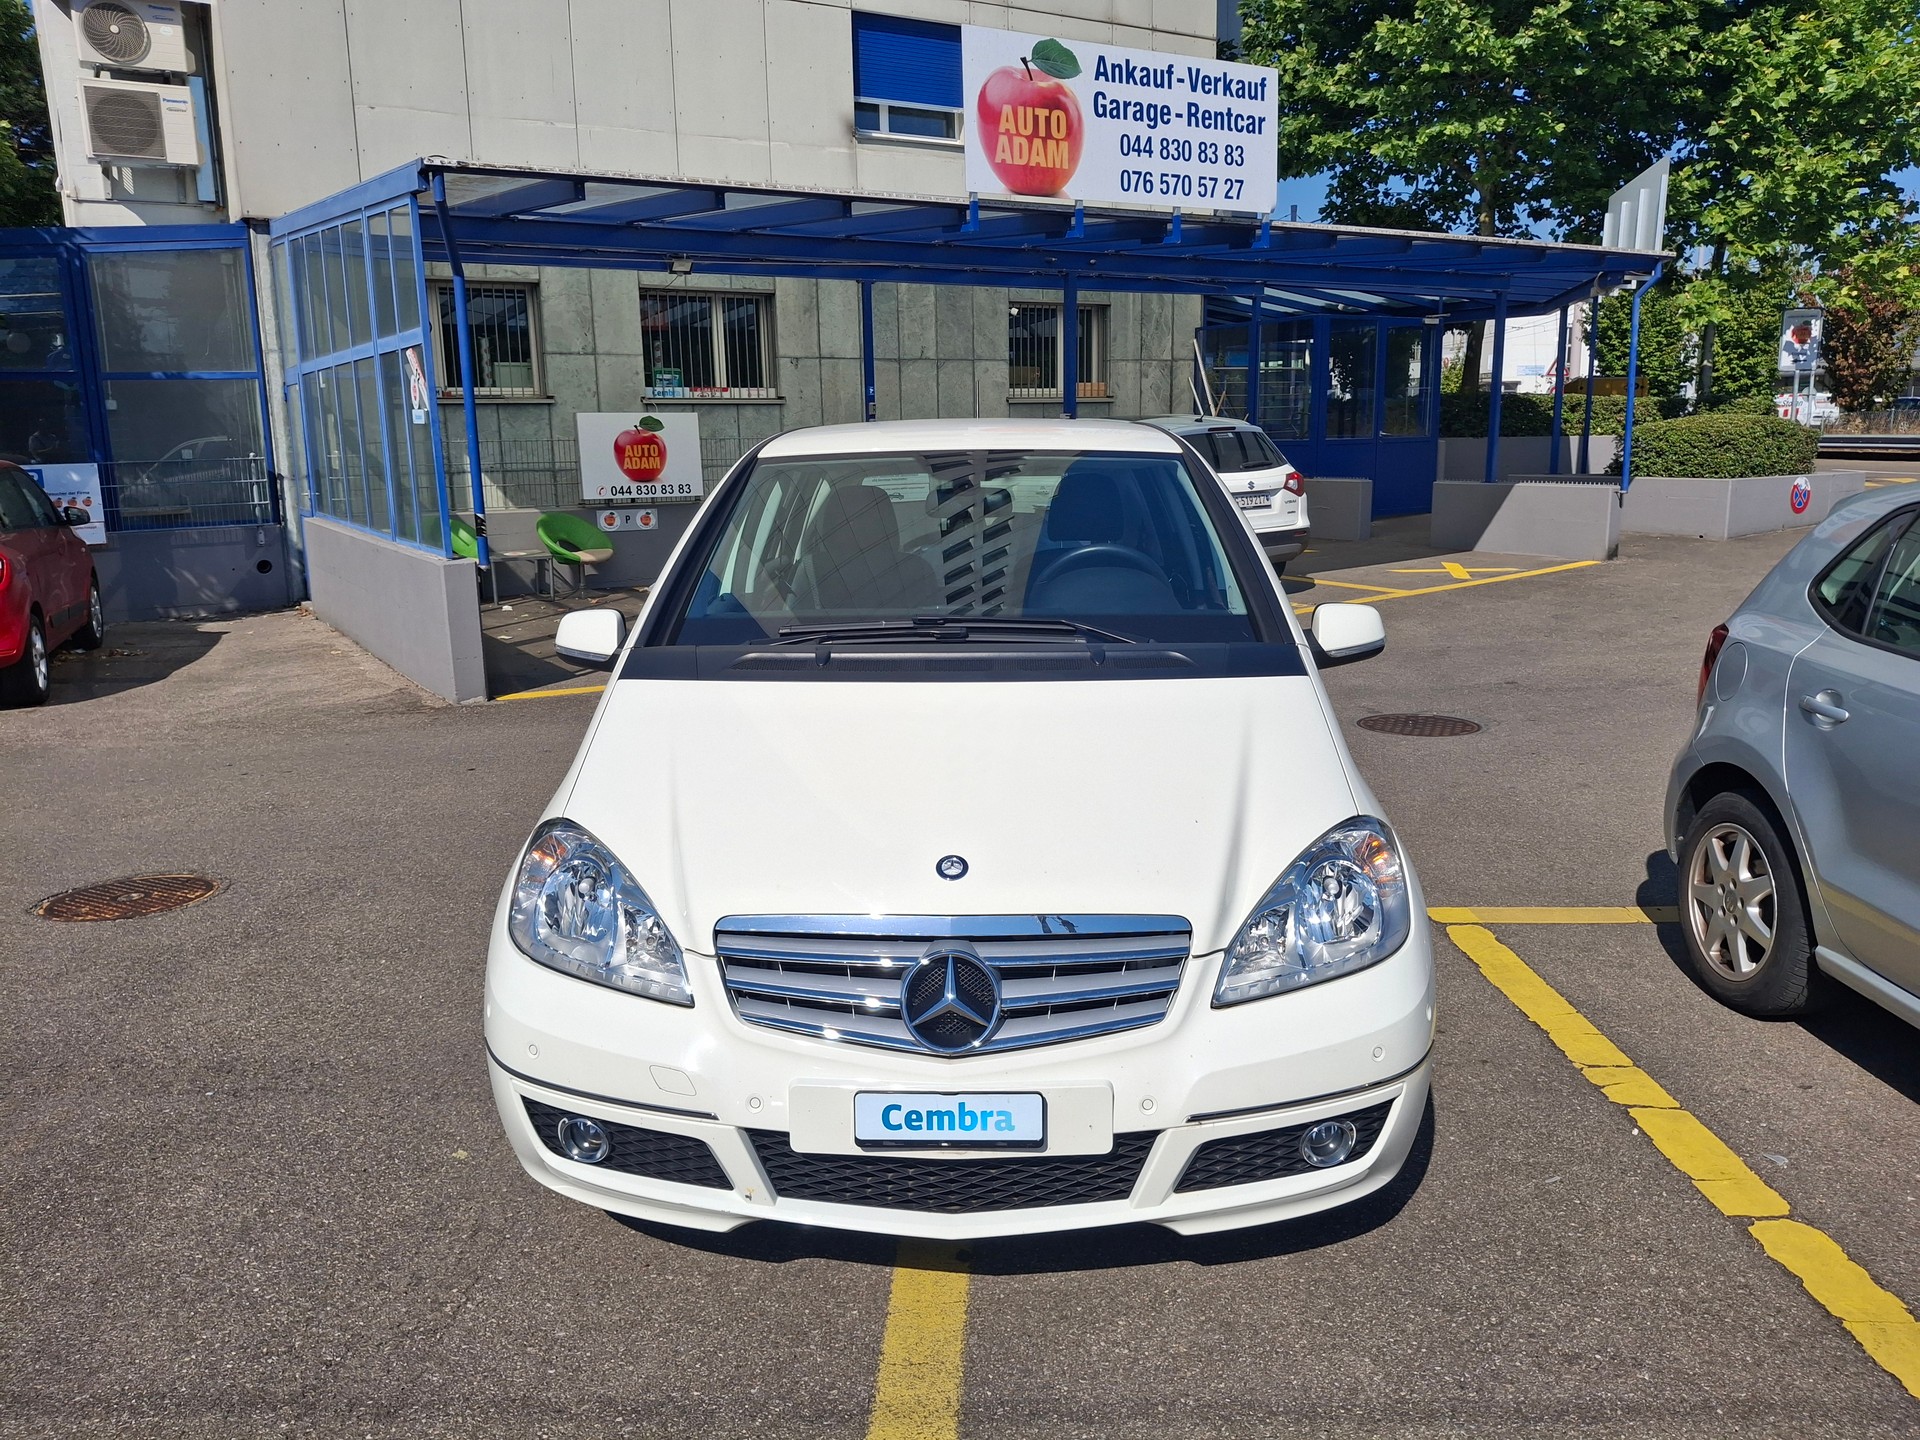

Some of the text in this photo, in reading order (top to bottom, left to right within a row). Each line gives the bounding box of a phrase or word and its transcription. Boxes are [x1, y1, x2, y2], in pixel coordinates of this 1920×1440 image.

[999, 104, 1067, 139] AUTO
[995, 134, 1069, 169] ADAM
[1120, 134, 1244, 167] 044 830 83 83
[1120, 169, 1244, 200] 076 570 57 27
[624, 457, 660, 470] ADAM
[625, 444, 659, 457] AUTO
[611, 483, 692, 496] 044 830 83 83
[625, 515, 631, 524] P
[881, 1101, 1016, 1132] Cembra
